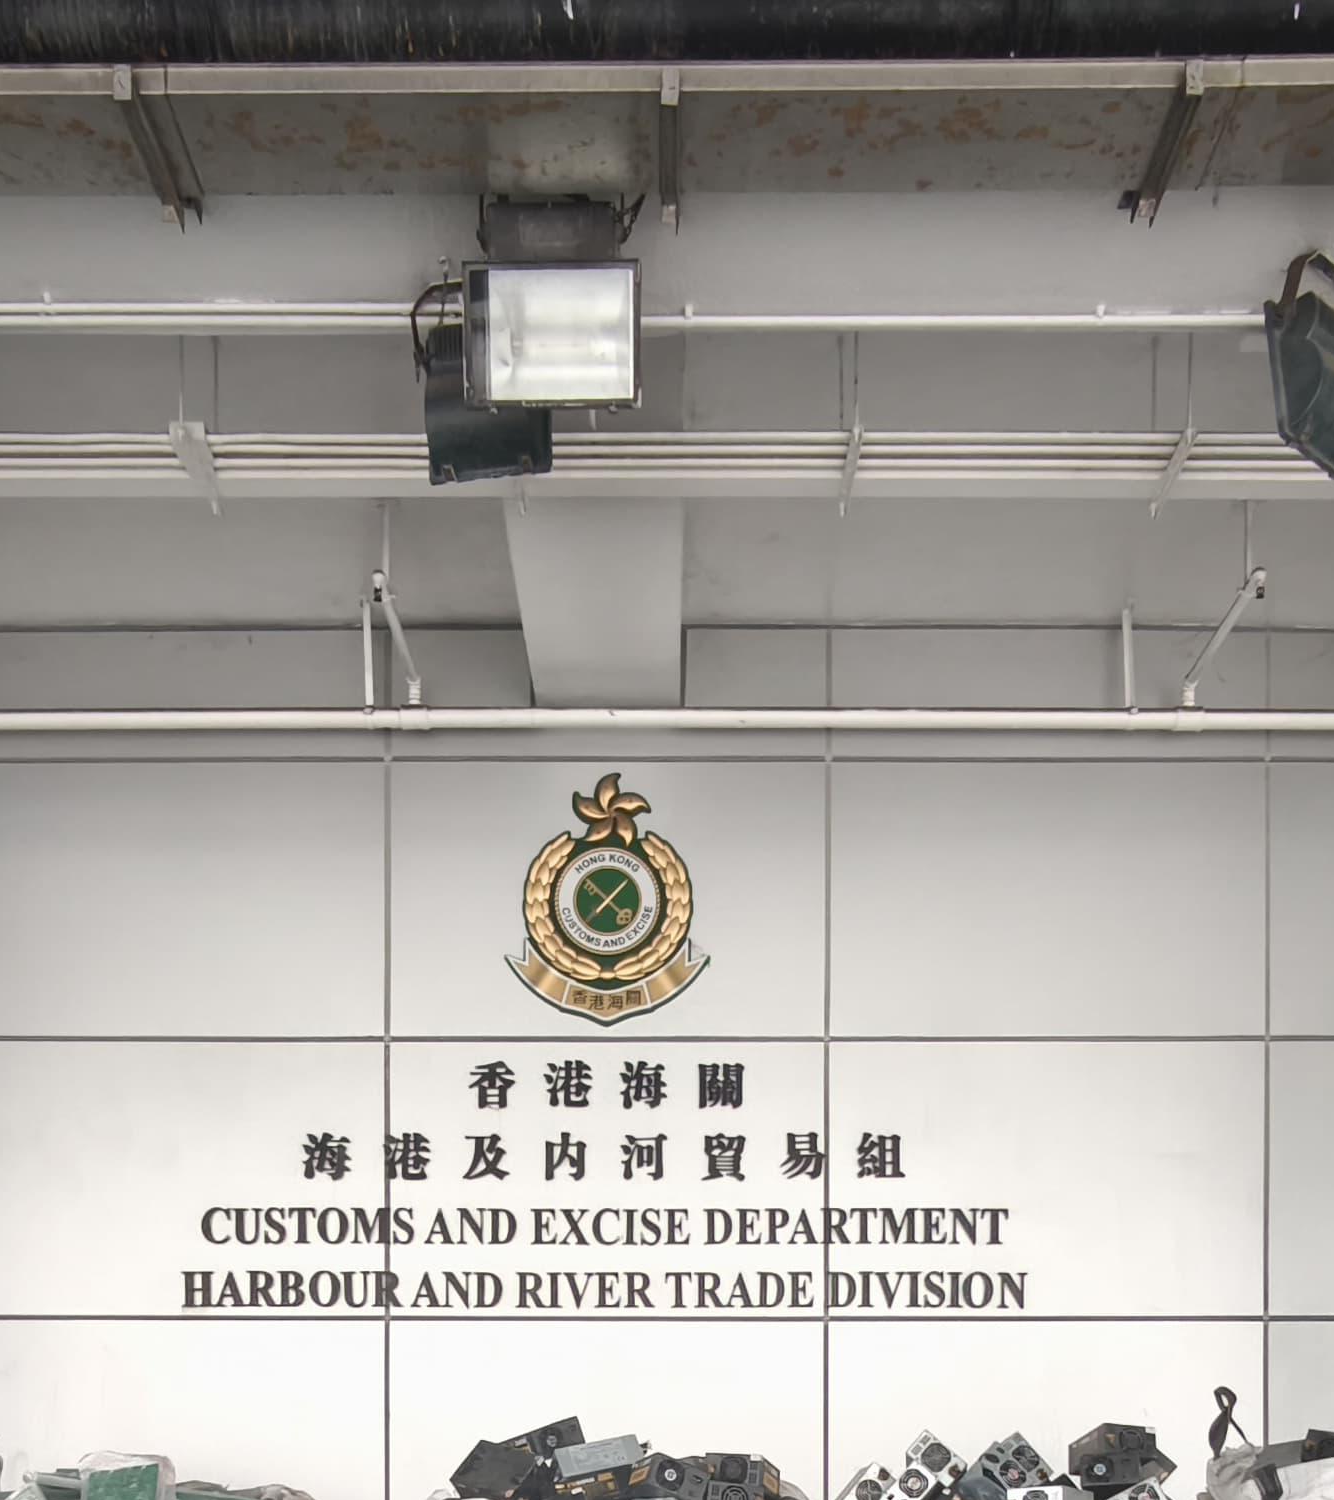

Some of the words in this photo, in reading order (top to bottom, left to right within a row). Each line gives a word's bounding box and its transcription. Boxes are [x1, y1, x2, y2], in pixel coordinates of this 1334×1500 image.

[575, 854, 607, 875] HONG
[608, 853, 640, 873] KONG
[561, 906, 601, 947] CUSTOMS
[602, 937, 626, 948] AND
[625, 905, 653, 941] EXCISE
[468, 1059, 745, 1110] 香港海關
[200, 1206, 415, 1245] CUSTOMS
[424, 1207, 517, 1245] AND
[530, 1207, 691, 1246] EXCISE
[704, 1207, 1009, 1246] DEPARTMENT
[181, 1270, 404, 1308] HARBOUR
[410, 1271, 504, 1308] AND
[516, 1271, 655, 1309] RIVER
[665, 1271, 815, 1308] TRADE
[826, 1271, 1028, 1310] DIVISION
